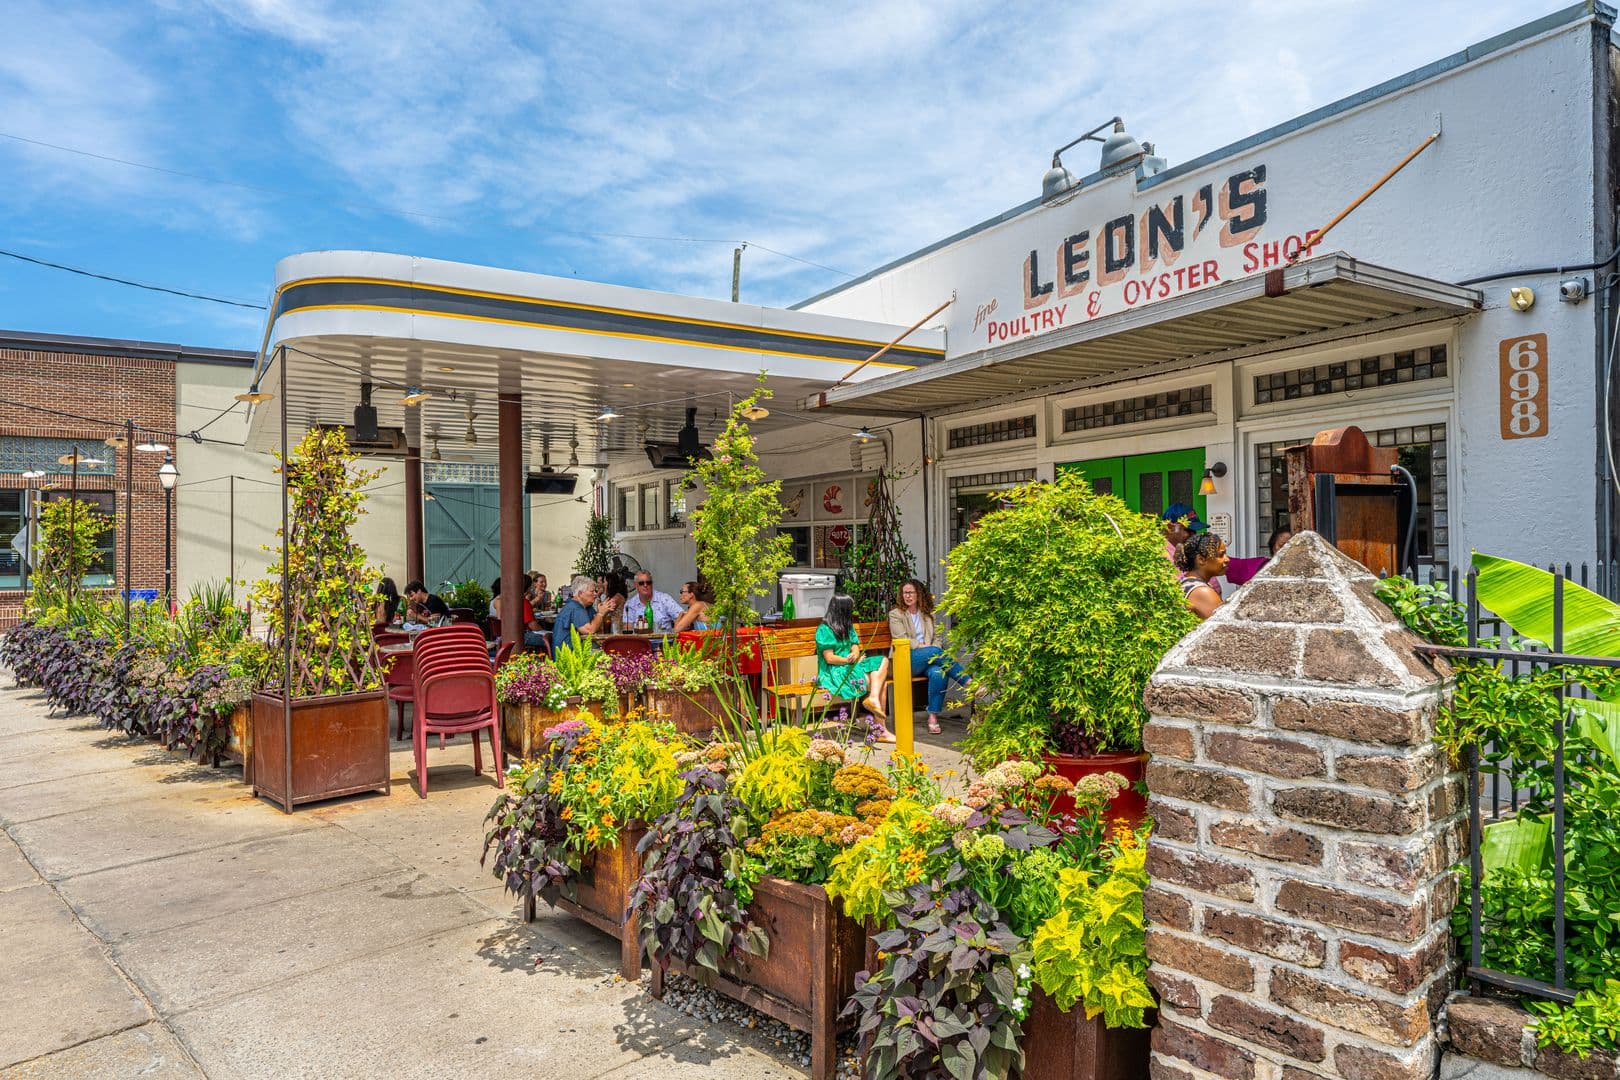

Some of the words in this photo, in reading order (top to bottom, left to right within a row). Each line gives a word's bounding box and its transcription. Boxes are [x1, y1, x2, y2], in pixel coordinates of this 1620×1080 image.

[972, 297, 998, 334] fine
[987, 303, 1068, 344] POULTRY
[1086, 289, 1103, 319] &
[1122, 259, 1222, 306] OYSTER
[1242, 228, 1325, 274] SHOP
[1024, 163, 1268, 310] LEON'S
[1508, 338, 1542, 436] 698
